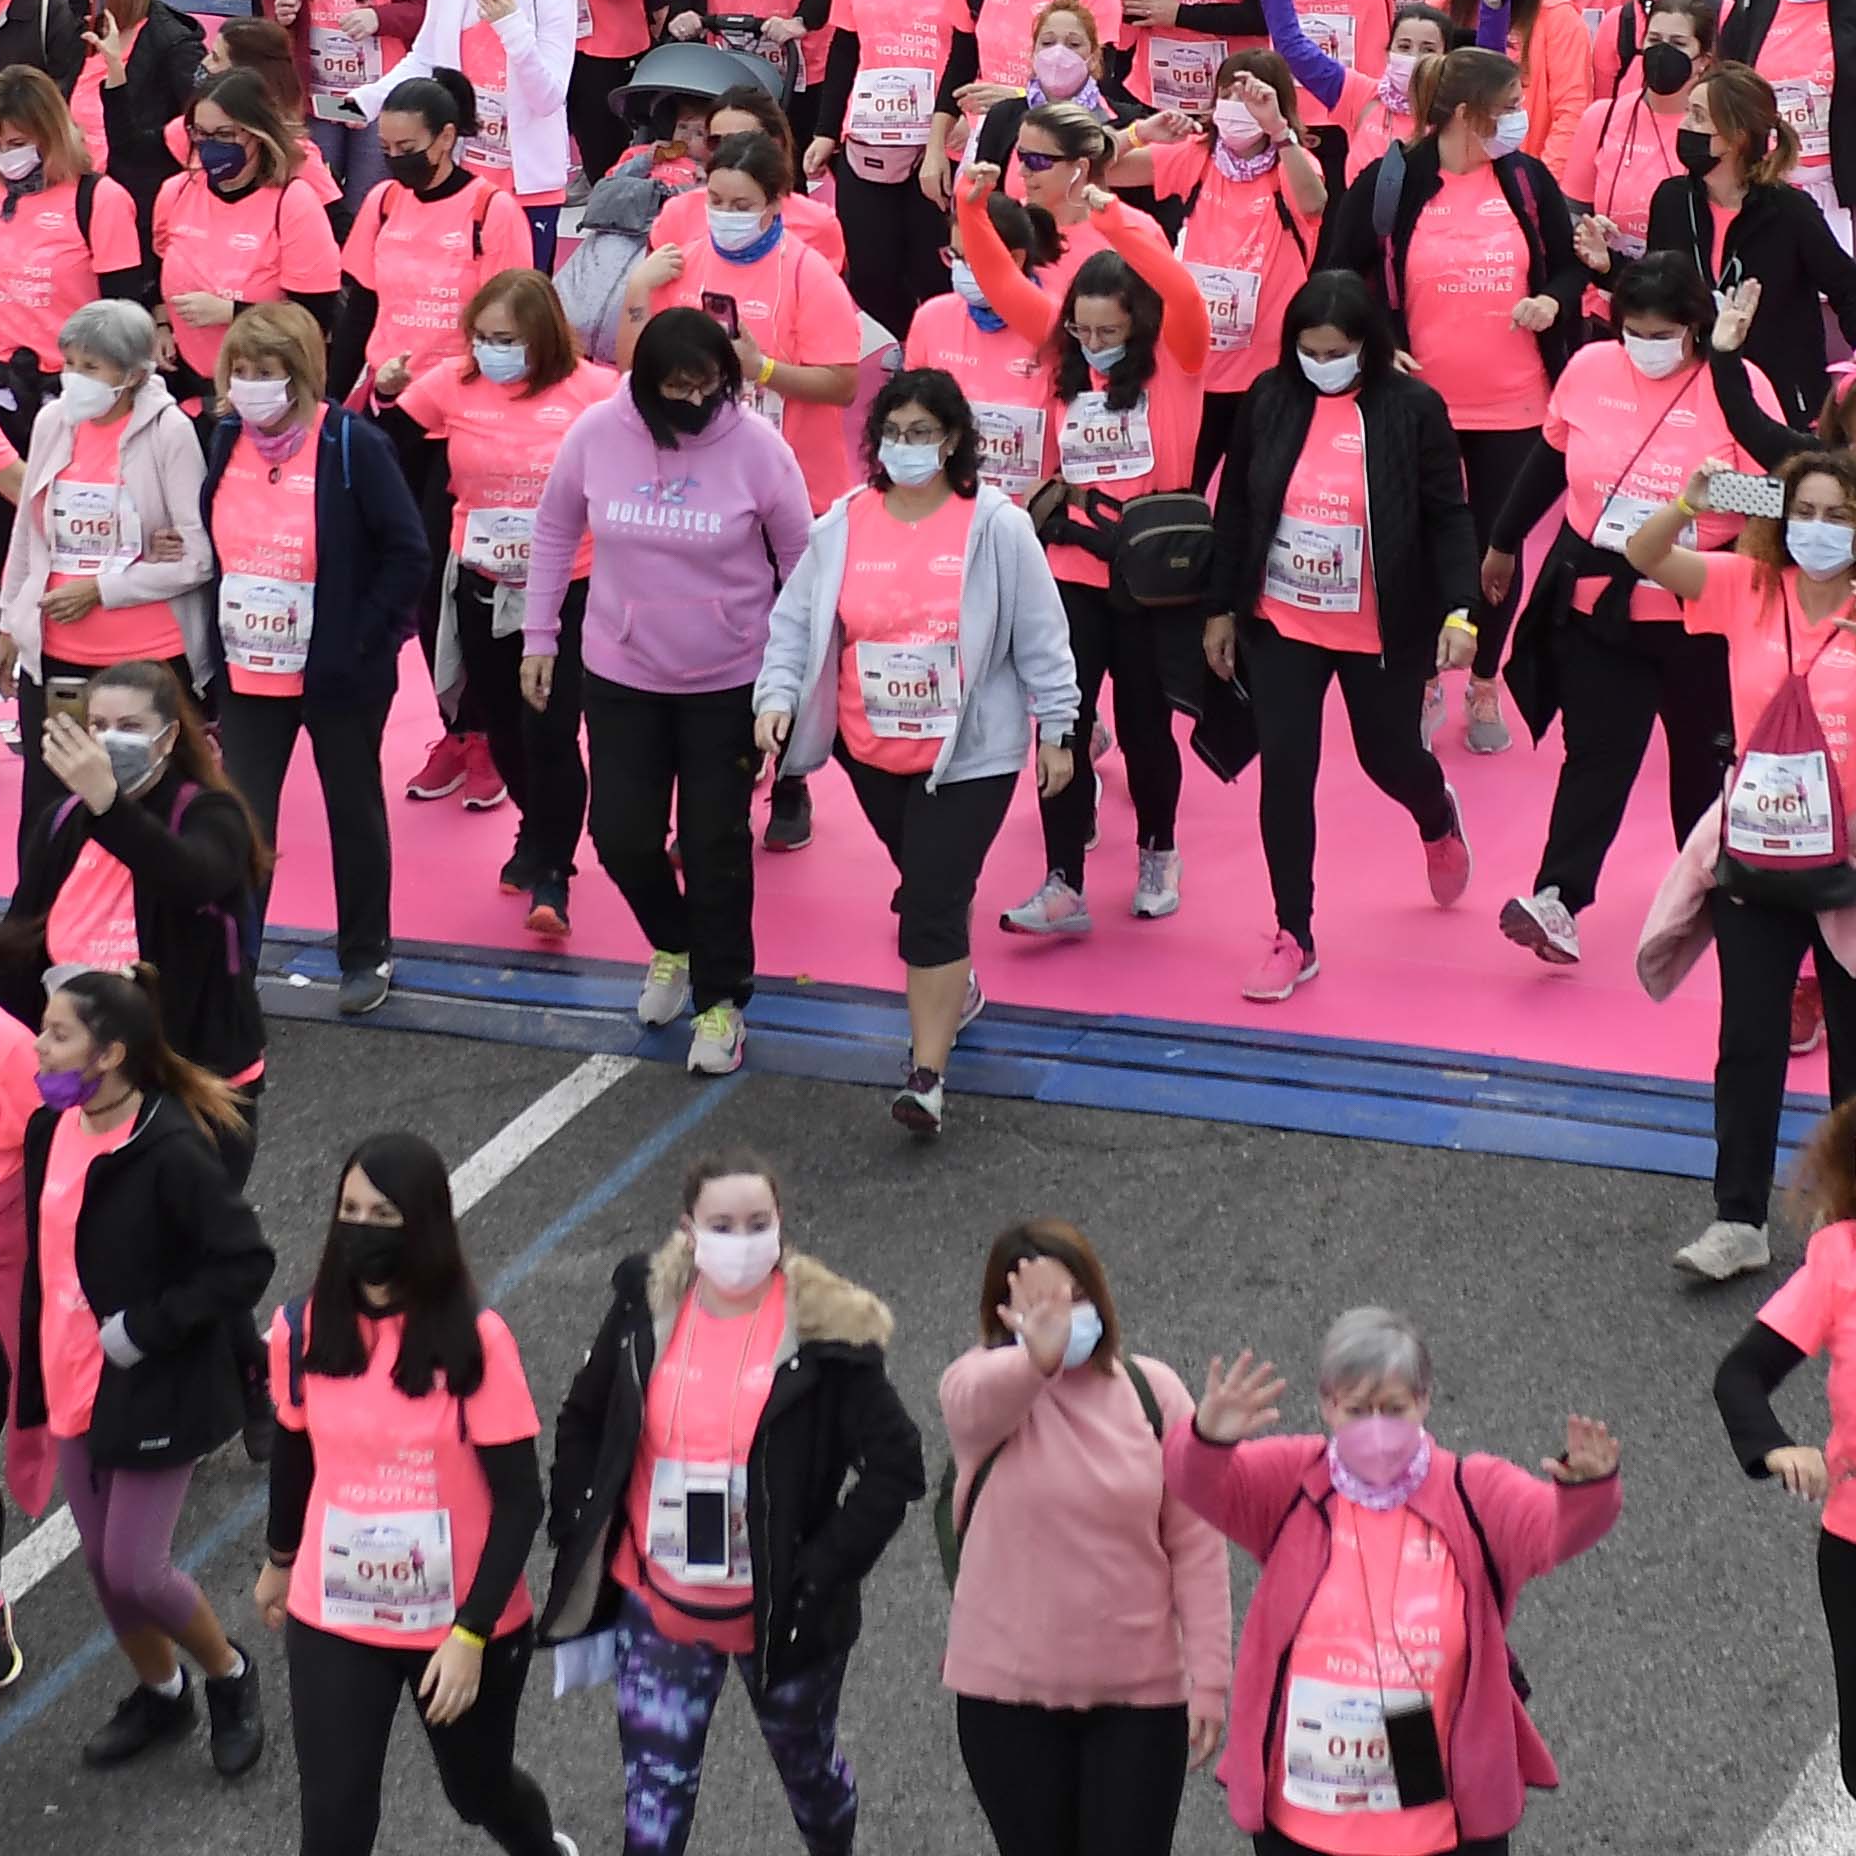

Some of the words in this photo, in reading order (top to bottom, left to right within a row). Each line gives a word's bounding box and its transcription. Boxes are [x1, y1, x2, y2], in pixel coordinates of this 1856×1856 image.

[913, 22, 937, 33] POR
[900, 33, 937, 48] TODAS
[324, 58, 356, 72] 016
[1173, 70, 1203, 83] 016
[876, 99, 908, 111] 016
[1485, 252, 1514, 263] POR
[1467, 268, 1515, 278] TODAS
[431, 288, 459, 298] POR
[1438, 282, 1513, 293] NOSOTRAS
[416, 301, 458, 313] TODAS
[392, 314, 458, 328] NOSOTRAS
[1084, 428, 1117, 443] 016
[1651, 464, 1682, 476] POR
[1631, 474, 1680, 493] TODAS
[606, 500, 722, 535] HOLLISTER
[70, 520, 110, 535] 016
[494, 544, 530, 559] 016
[1293, 555, 1331, 574] 016
[246, 614, 285, 632] 016
[888, 681, 928, 697] 016
[1757, 795, 1796, 813] 016
[358, 1562, 409, 1578] 016
[1329, 1738, 1385, 1759] 016
